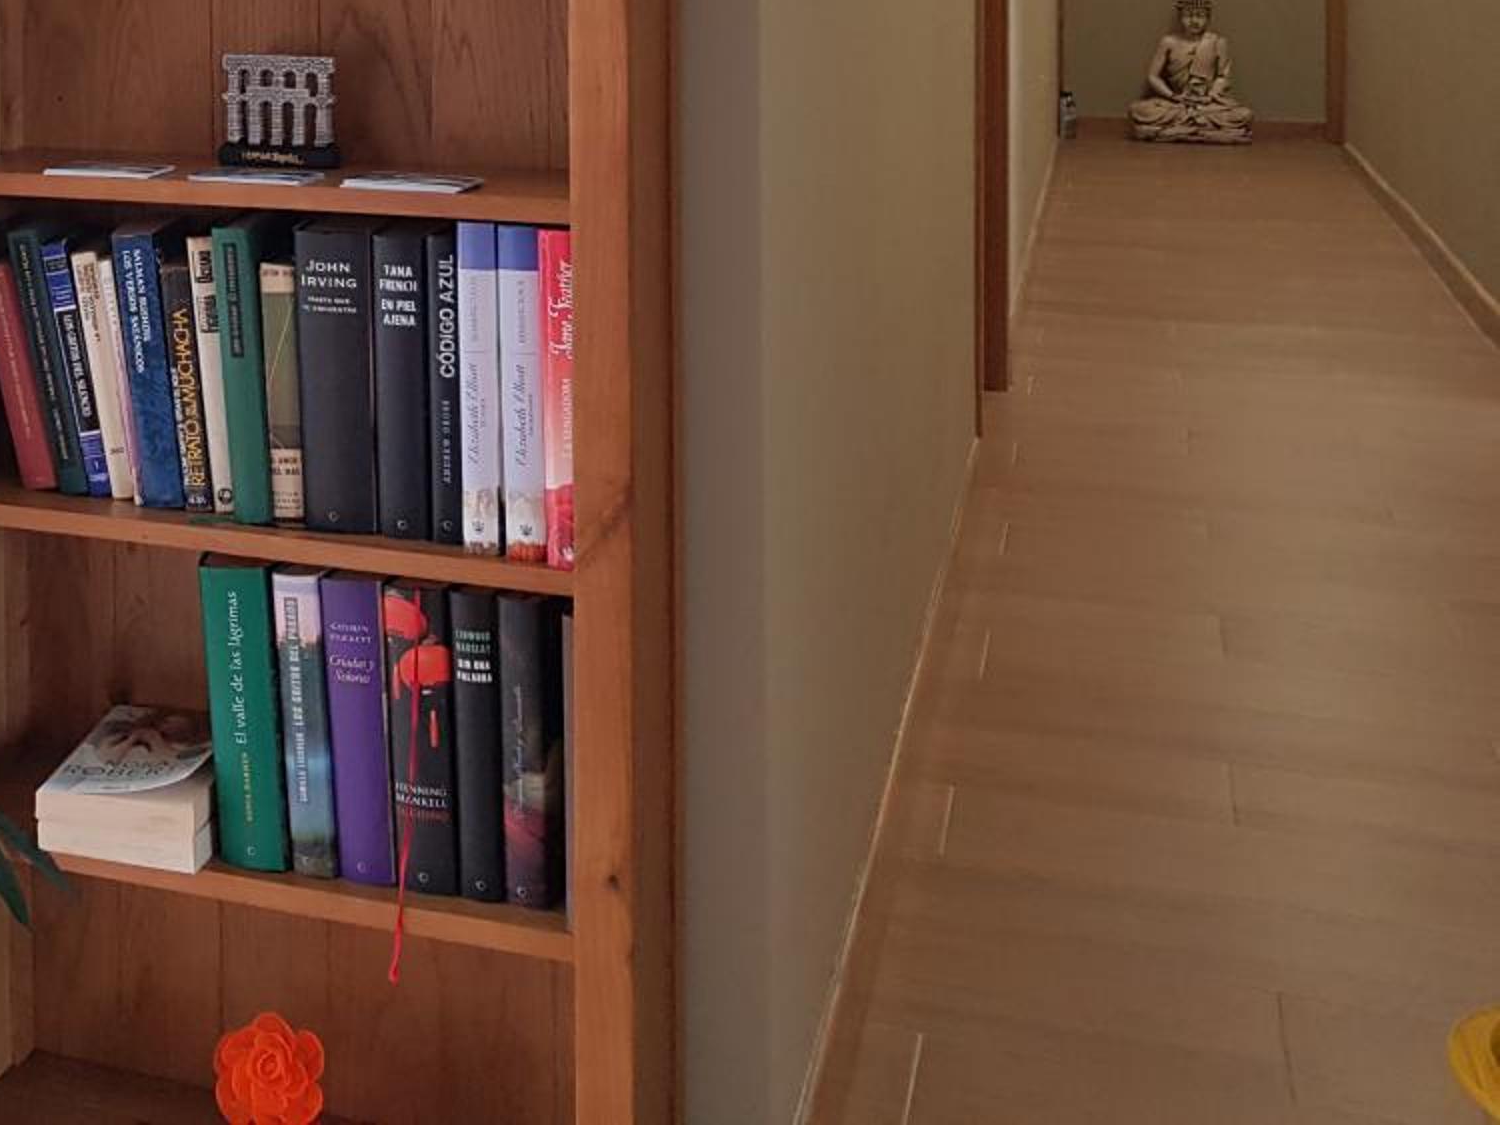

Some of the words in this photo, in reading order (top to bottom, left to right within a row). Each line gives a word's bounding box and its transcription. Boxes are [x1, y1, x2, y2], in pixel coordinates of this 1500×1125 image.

[122, 250, 132, 271] LOS
[306, 259, 351, 273] JOHN
[133, 249, 146, 294] SALMAN
[383, 264, 413, 277] TANA
[438, 254, 454, 304] AZUL
[301, 274, 357, 288] IRVING
[380, 278, 418, 292] FRENCH
[125, 272, 138, 313] VERSOS
[381, 298, 394, 310] EN
[396, 300, 417, 312] PIEL
[383, 314, 416, 326] AJENA
[436, 306, 456, 379] CÓDIGO
[171, 308, 197, 405] MUCHACHA
[185, 419, 206, 487] RETRATO
[227, 590, 242, 647] lágrimas
[230, 652, 243, 670] las
[288, 644, 299, 662] DEL
[329, 654, 367, 668] Criadas
[230, 673, 244, 692] de
[230, 695, 246, 730] valle
[293, 706, 304, 726] LOS
[236, 730, 248, 746] El
